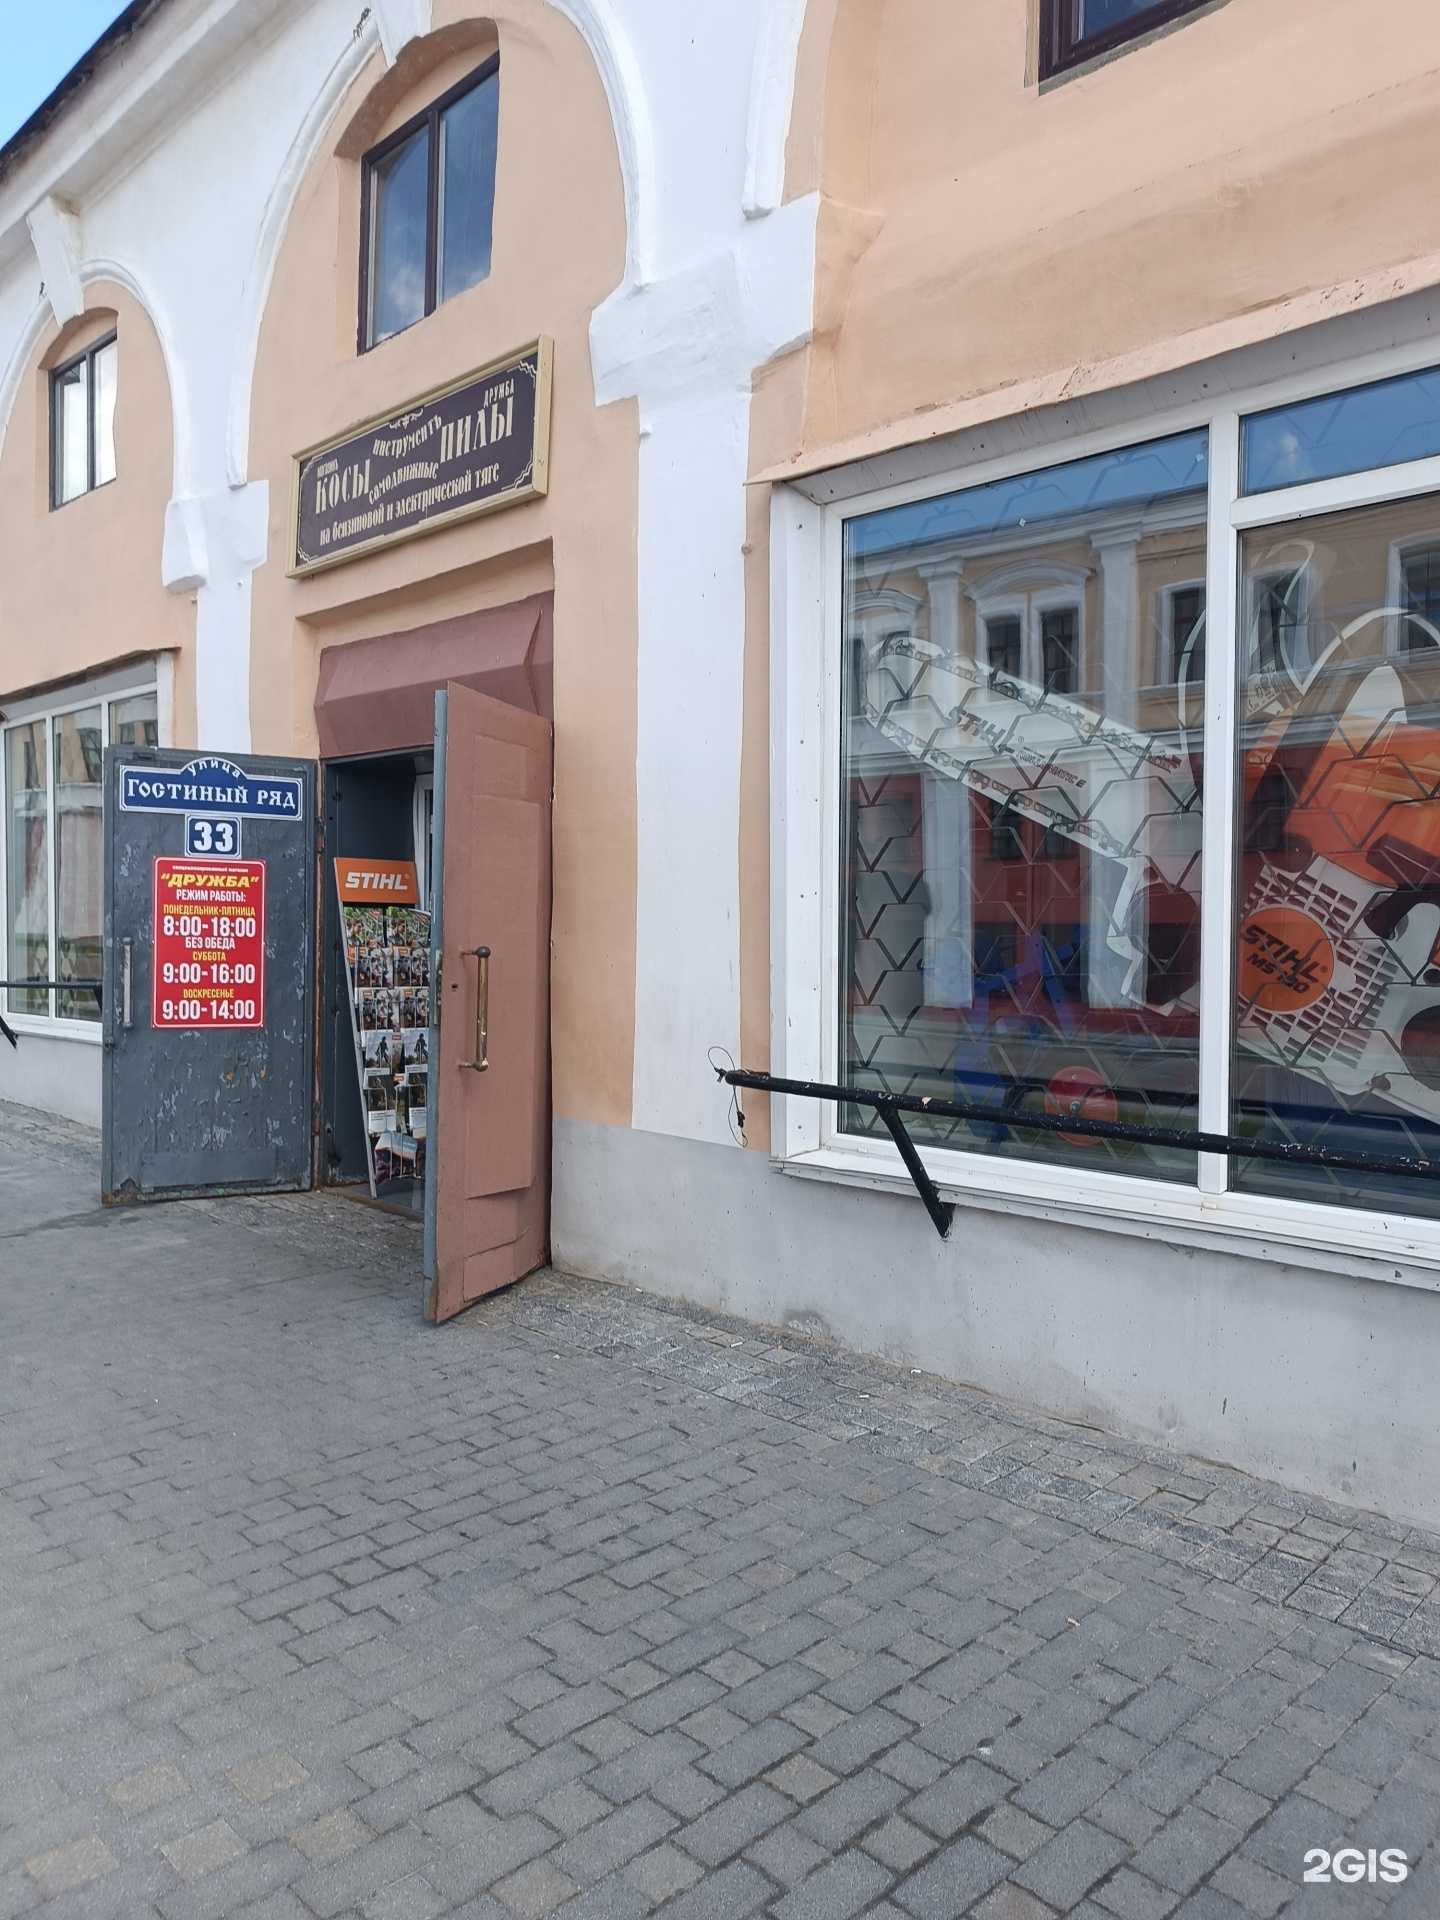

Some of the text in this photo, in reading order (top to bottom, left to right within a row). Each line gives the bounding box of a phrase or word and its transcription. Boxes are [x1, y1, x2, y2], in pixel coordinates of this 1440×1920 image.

[440, 396, 513, 463] ПИЛЫ
[315, 459, 370, 514] КОСЫ
[320, 462, 500, 546] на бензиновой и электрической тяге
[188, 758, 240, 778] улица
[193, 821, 233, 852] 33
[345, 872, 408, 890] STIHL
[176, 889, 246, 902] РЕЖИМ РАБОТЫ:
[185, 937, 236, 950] БЕЗ ОБЕДА
[192, 951, 226, 961] СУББОТА
[1244, 925, 1321, 983] STIHL
[183, 988, 234, 998] ВОСКРЕСЕНЬЕ
